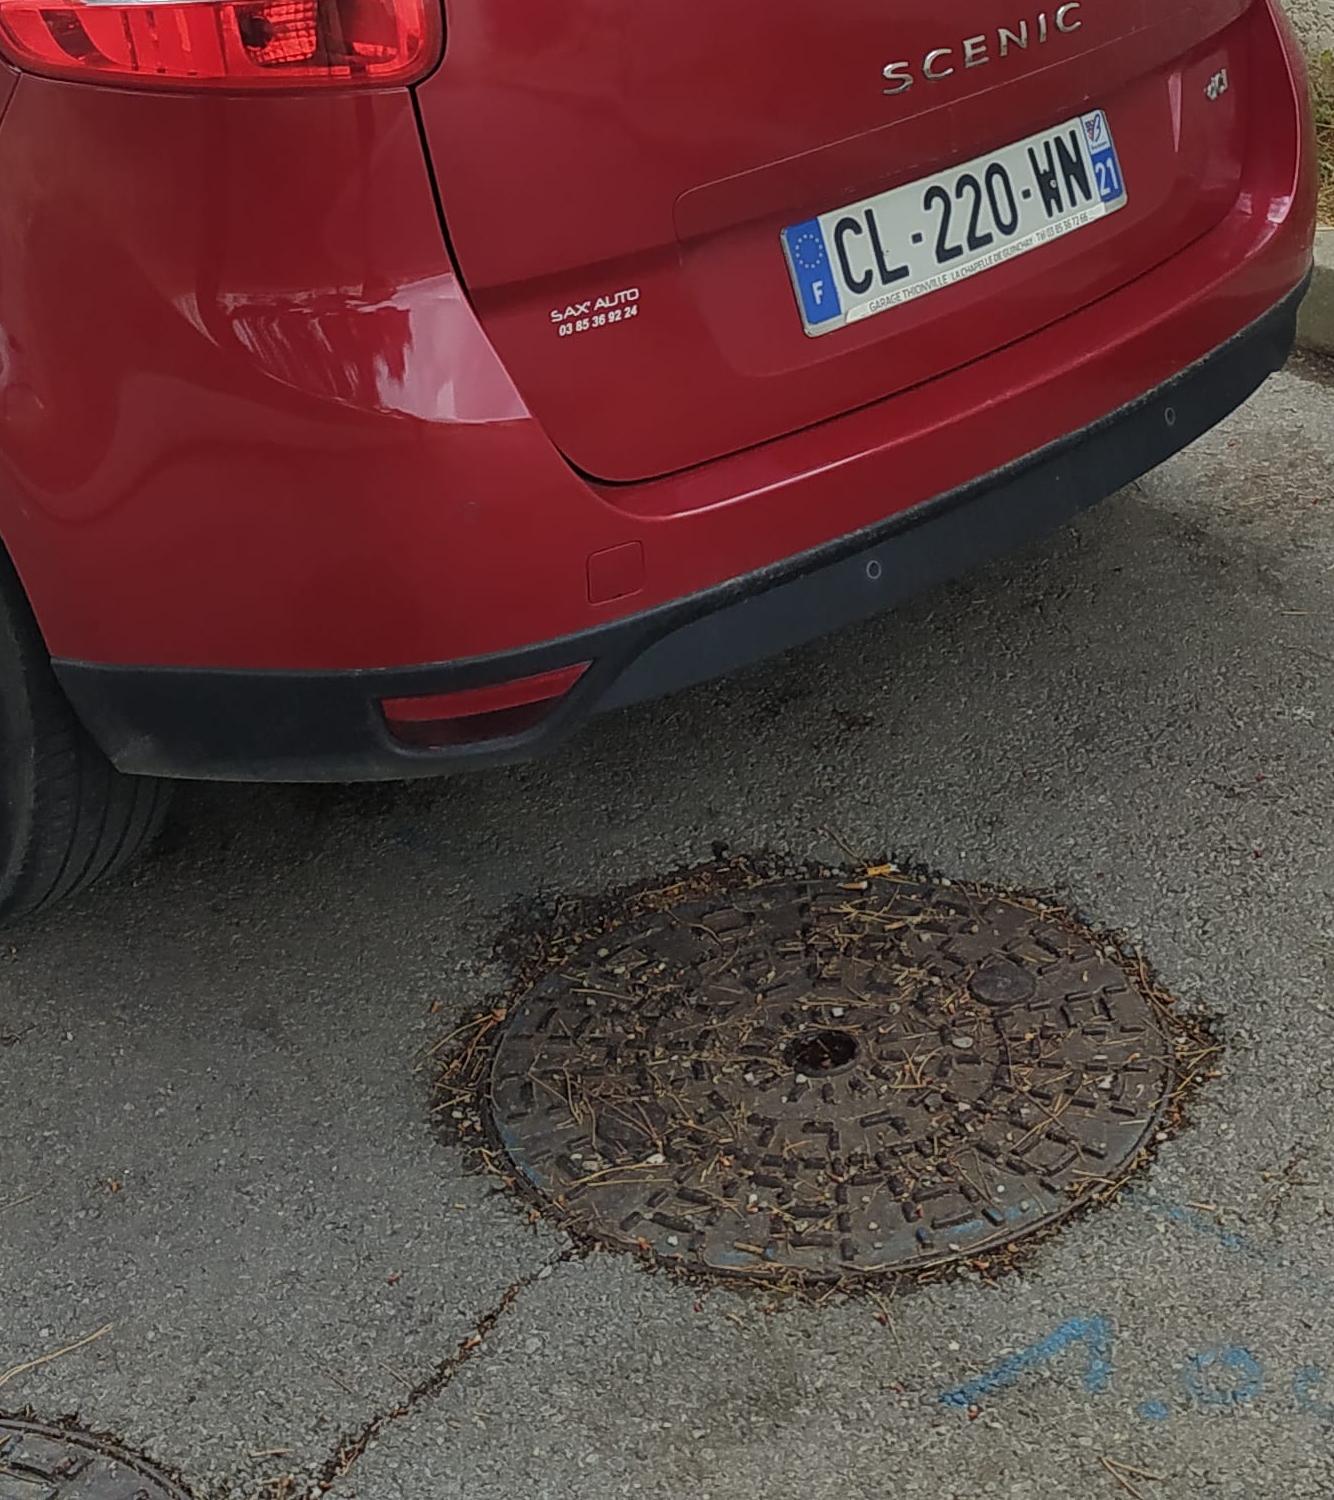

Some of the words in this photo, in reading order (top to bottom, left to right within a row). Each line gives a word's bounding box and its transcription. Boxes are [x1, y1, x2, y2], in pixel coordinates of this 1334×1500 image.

[881, 2, 1082, 95] SCENIC
[1095, 157, 1119, 197] 21
[834, 129, 1093, 294] CL-220-WN
[594, 288, 640, 310] AUTO
[812, 280, 823, 305] F
[869, 292, 901, 312] GARAGE
[559, 323, 573, 336] 03
[575, 318, 590, 331] 85
[592, 314, 606, 327] 36
[608, 309, 622, 322] 92
[624, 305, 637, 318] 24
